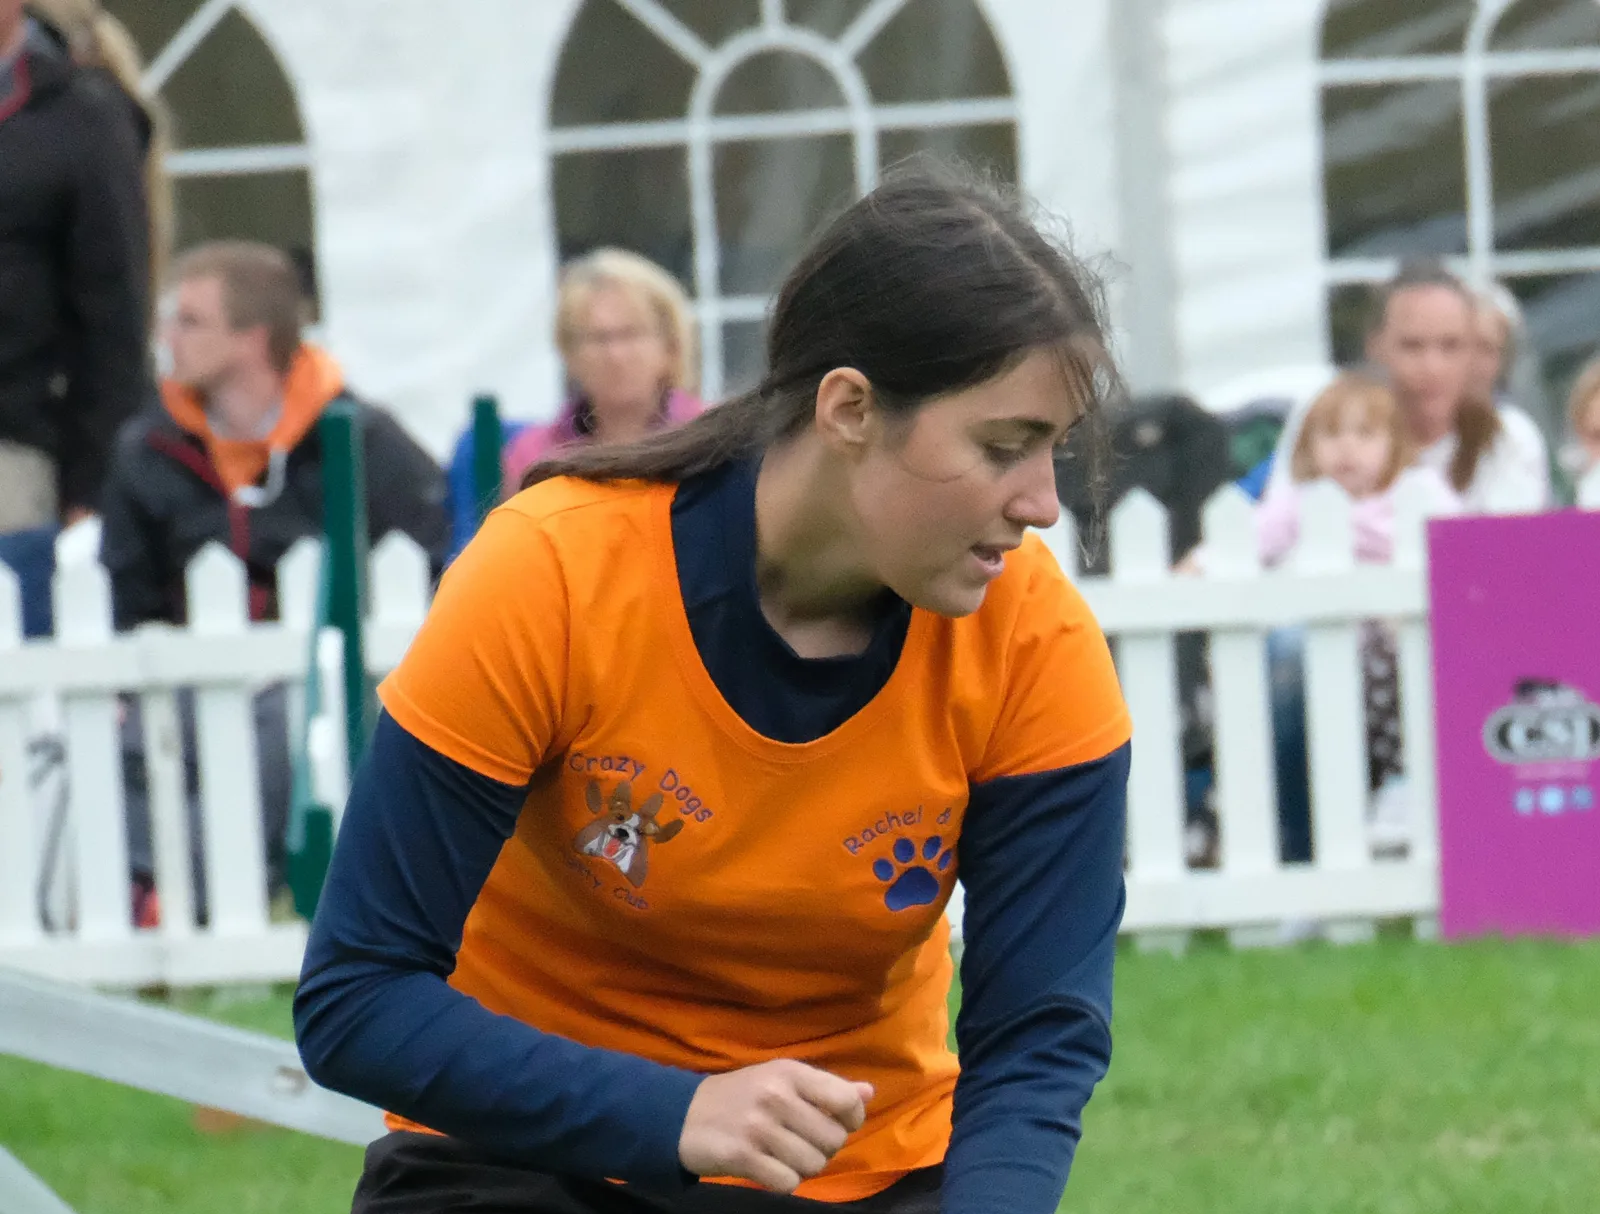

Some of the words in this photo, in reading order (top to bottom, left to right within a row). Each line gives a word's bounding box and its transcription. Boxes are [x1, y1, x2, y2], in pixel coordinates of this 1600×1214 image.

[1505, 711, 1589, 759] CSJ
[569, 752, 647, 781] Crazy
[660, 768, 714, 823] Dogs
[843, 804, 924, 855] Rachel
